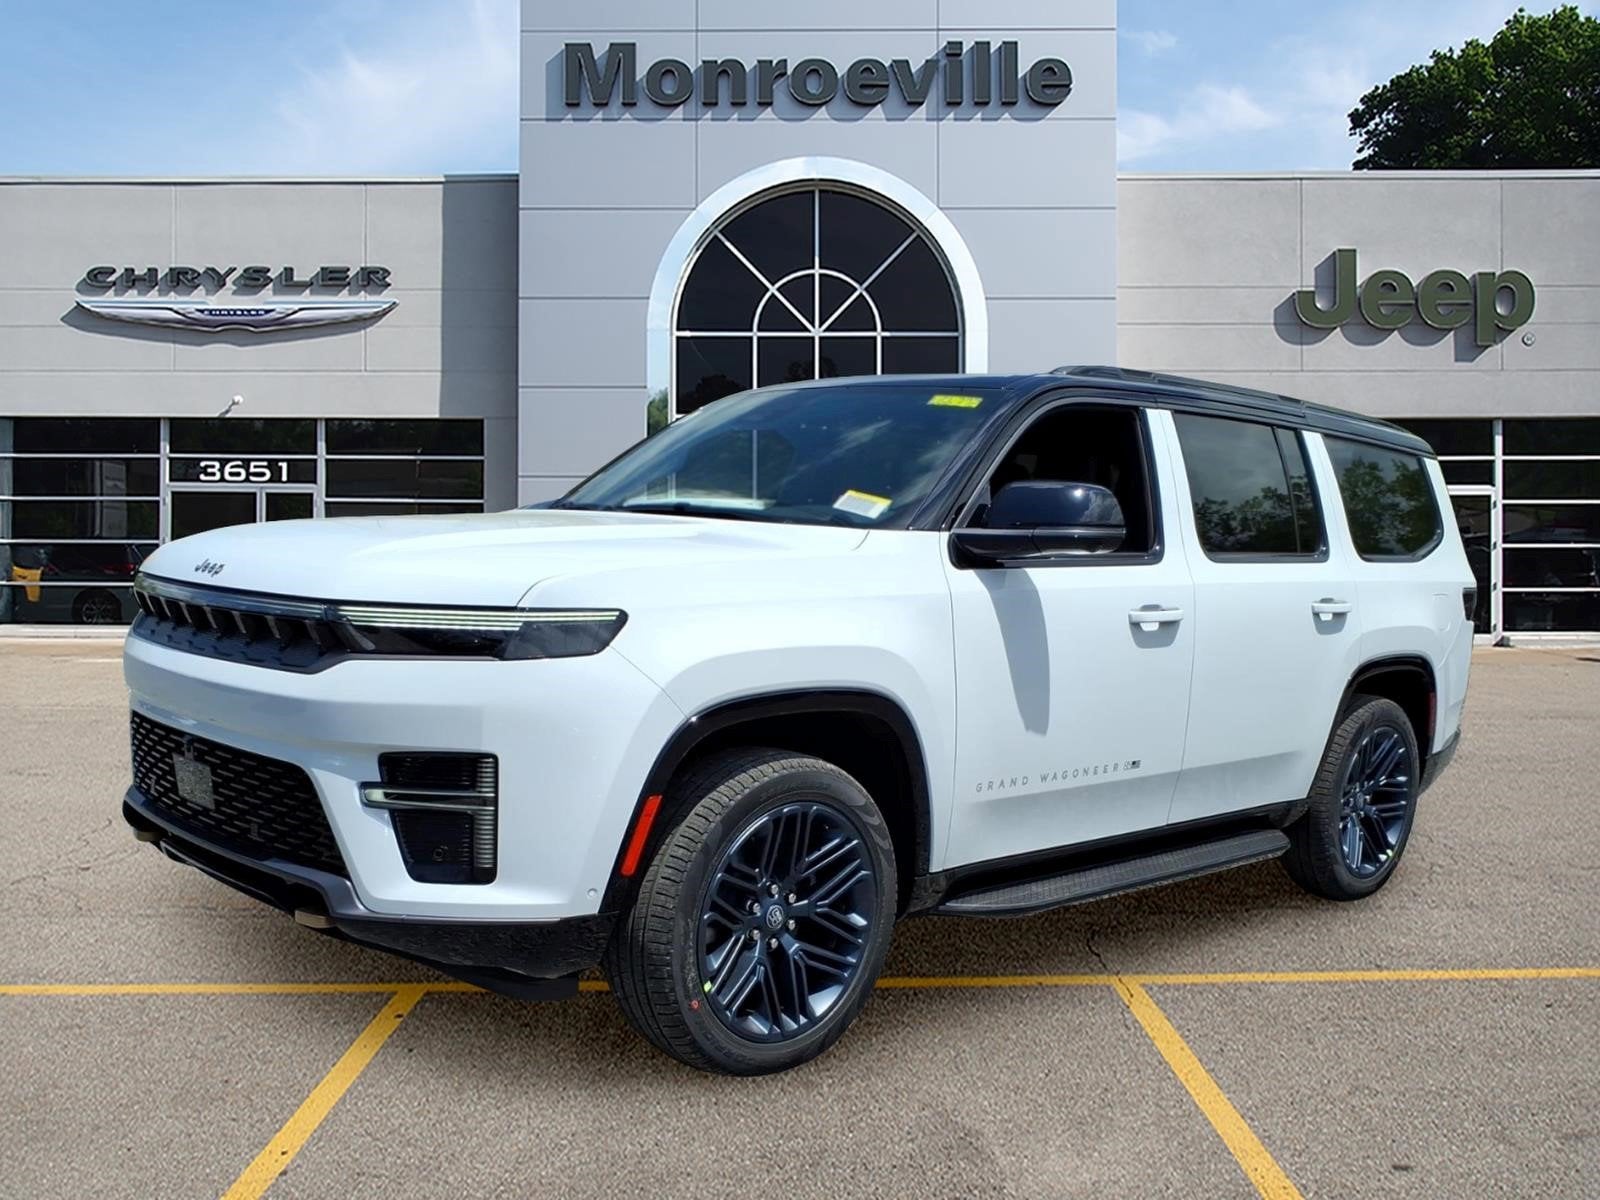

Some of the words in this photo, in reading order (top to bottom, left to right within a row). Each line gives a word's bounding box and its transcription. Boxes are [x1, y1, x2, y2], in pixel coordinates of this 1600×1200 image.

[563, 40, 1074, 108] Monroeville
[85, 266, 391, 288] CHRYSLER
[1294, 248, 1535, 346] Jeep
[199, 461, 288, 481] 3651
[194, 558, 224, 578] Jeep
[975, 775, 1029, 793] GRAND
[1040, 762, 1119, 783] WAGONEER
